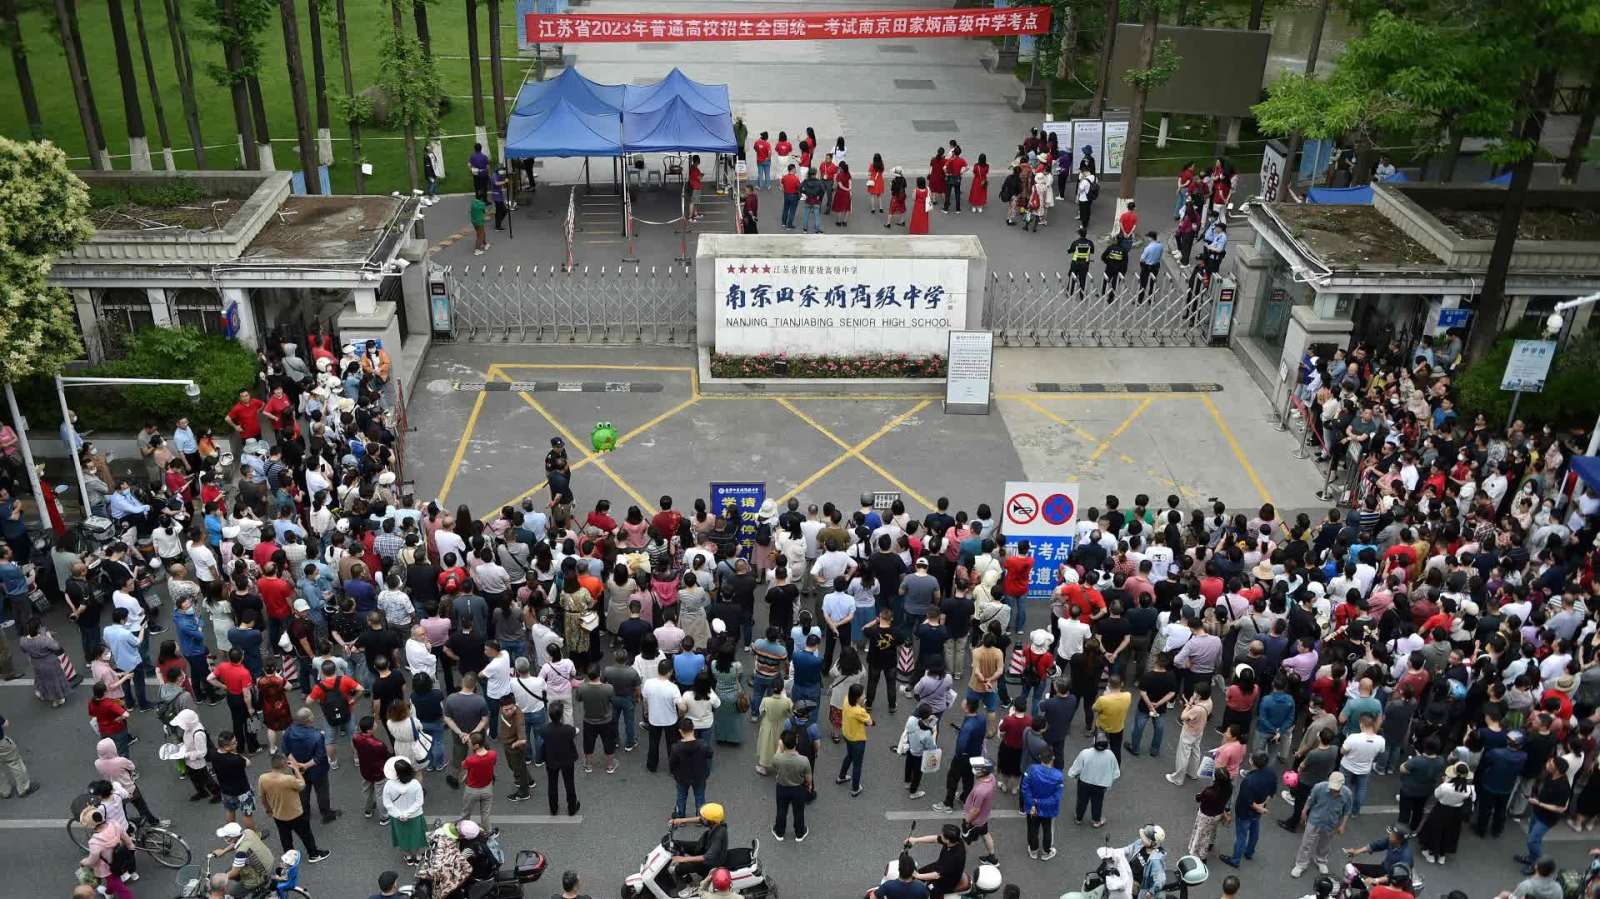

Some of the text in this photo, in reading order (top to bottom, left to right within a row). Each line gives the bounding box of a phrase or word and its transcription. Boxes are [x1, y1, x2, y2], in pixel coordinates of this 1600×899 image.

[538, 13, 1039, 38] 江苏省2023年普通高校招生全国统一考试南京田家炳高级中学考点
[773, 265, 858, 275] 江苏省四星级高级中学
[726, 283, 944, 310] 南京田家炳高级中学
[726, 318, 952, 327] NANJING TIANJIABING SENIOR HIGH SCHOOL
